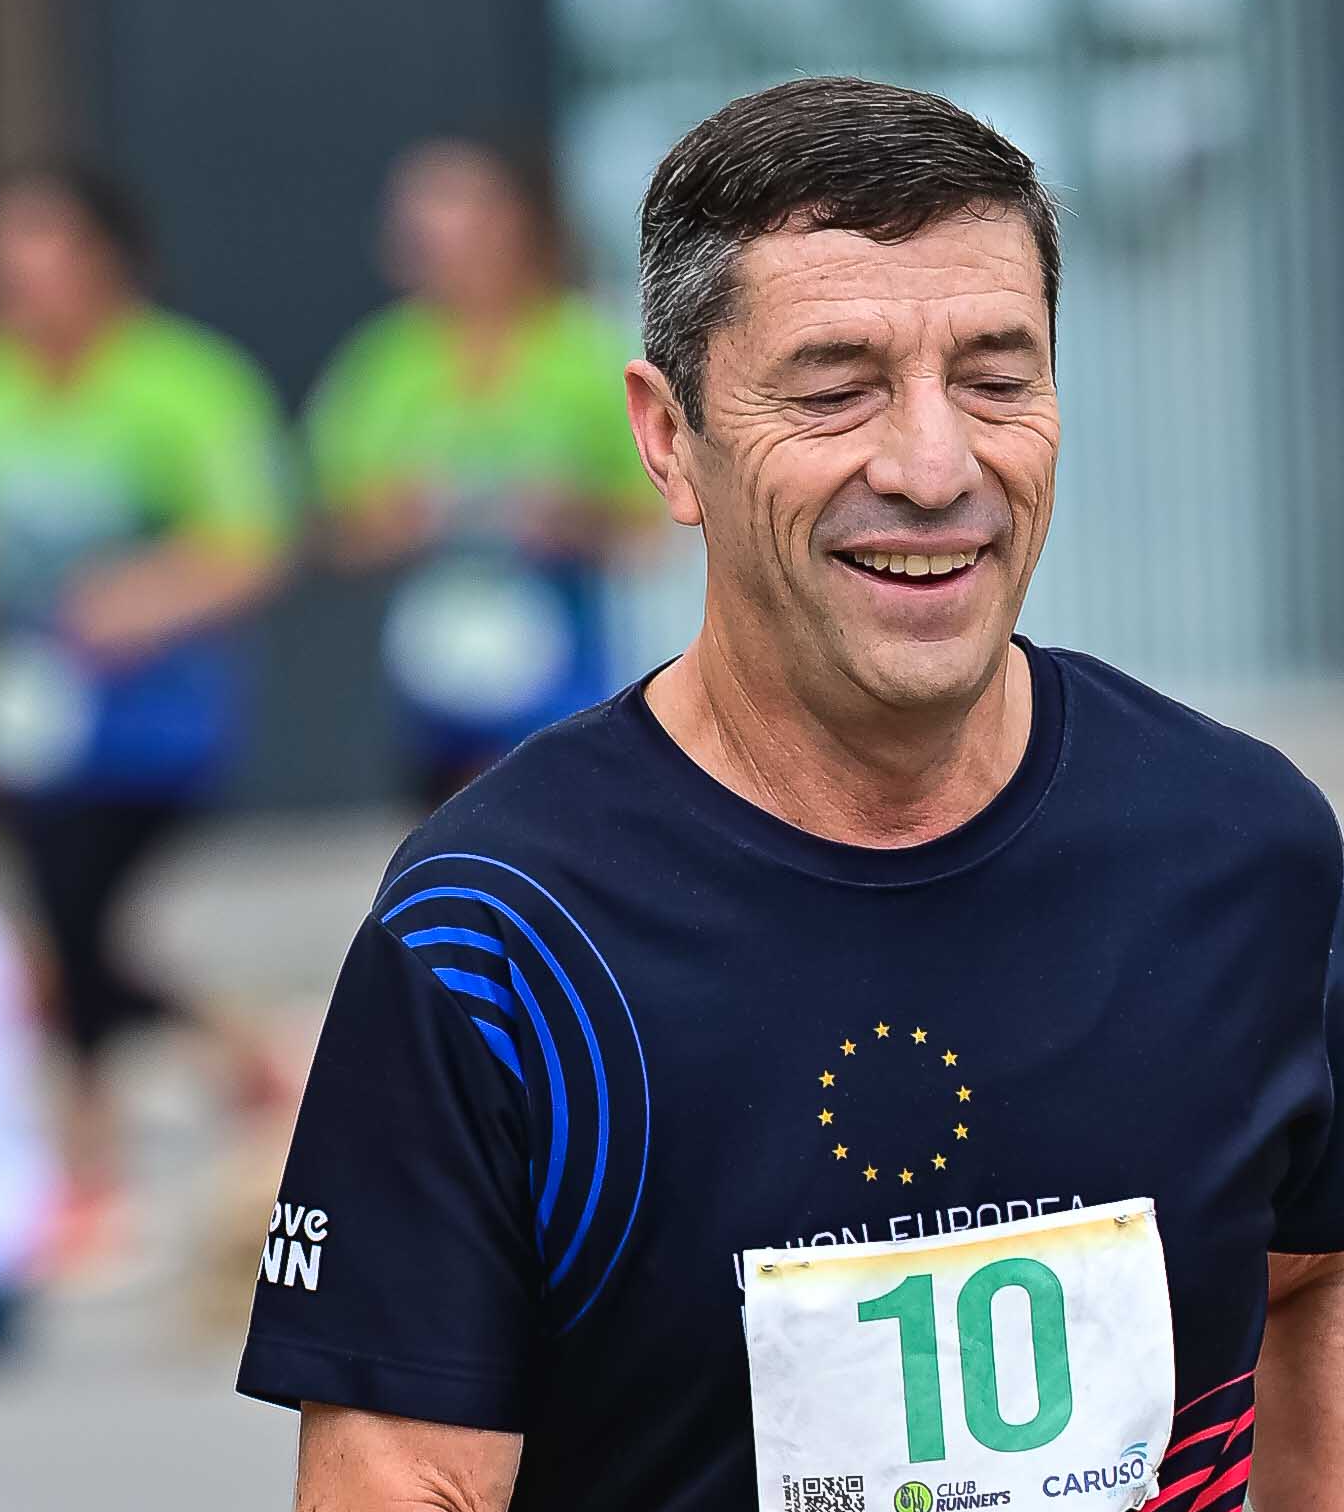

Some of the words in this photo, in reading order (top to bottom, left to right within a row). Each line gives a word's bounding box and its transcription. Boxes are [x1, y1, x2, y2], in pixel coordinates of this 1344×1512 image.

[857, 1257, 1073, 1464] 10
[936, 1480, 976, 1497] CLUB
[1042, 1458, 1144, 1498] CARUSO
